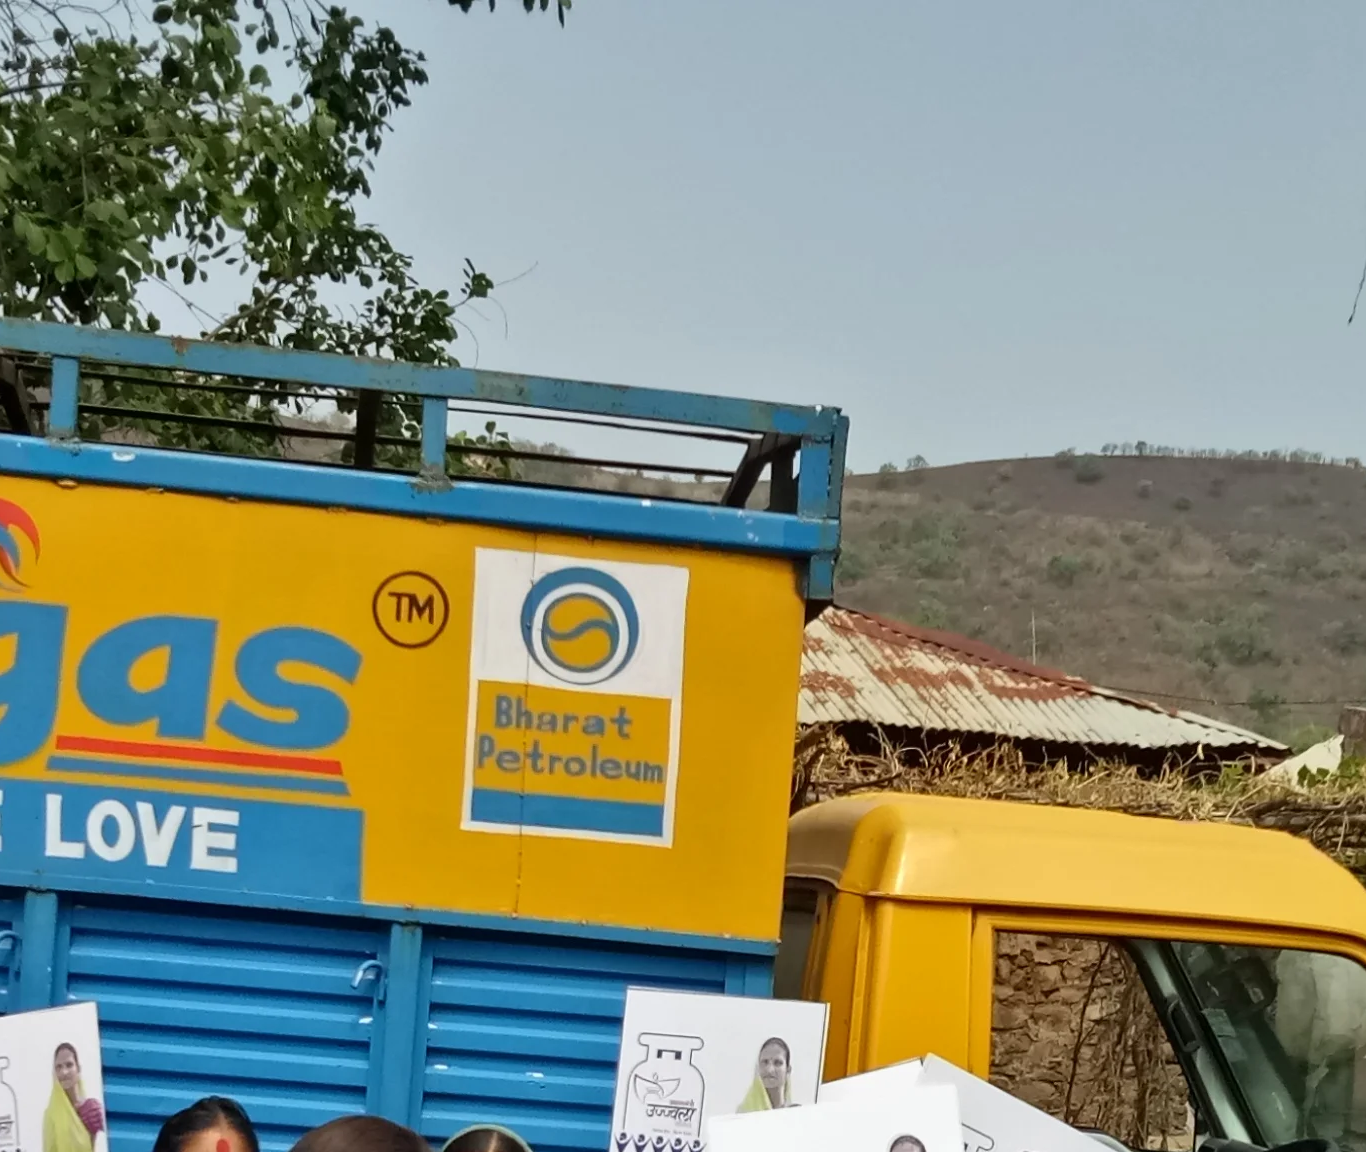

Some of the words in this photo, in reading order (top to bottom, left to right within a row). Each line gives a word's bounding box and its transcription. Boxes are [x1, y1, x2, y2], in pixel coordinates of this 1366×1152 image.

[388, 591, 435, 625] TM
[494, 695, 632, 740] Bharat
[476, 734, 664, 784] Petroleum
[45, 793, 240, 873] LOVE
